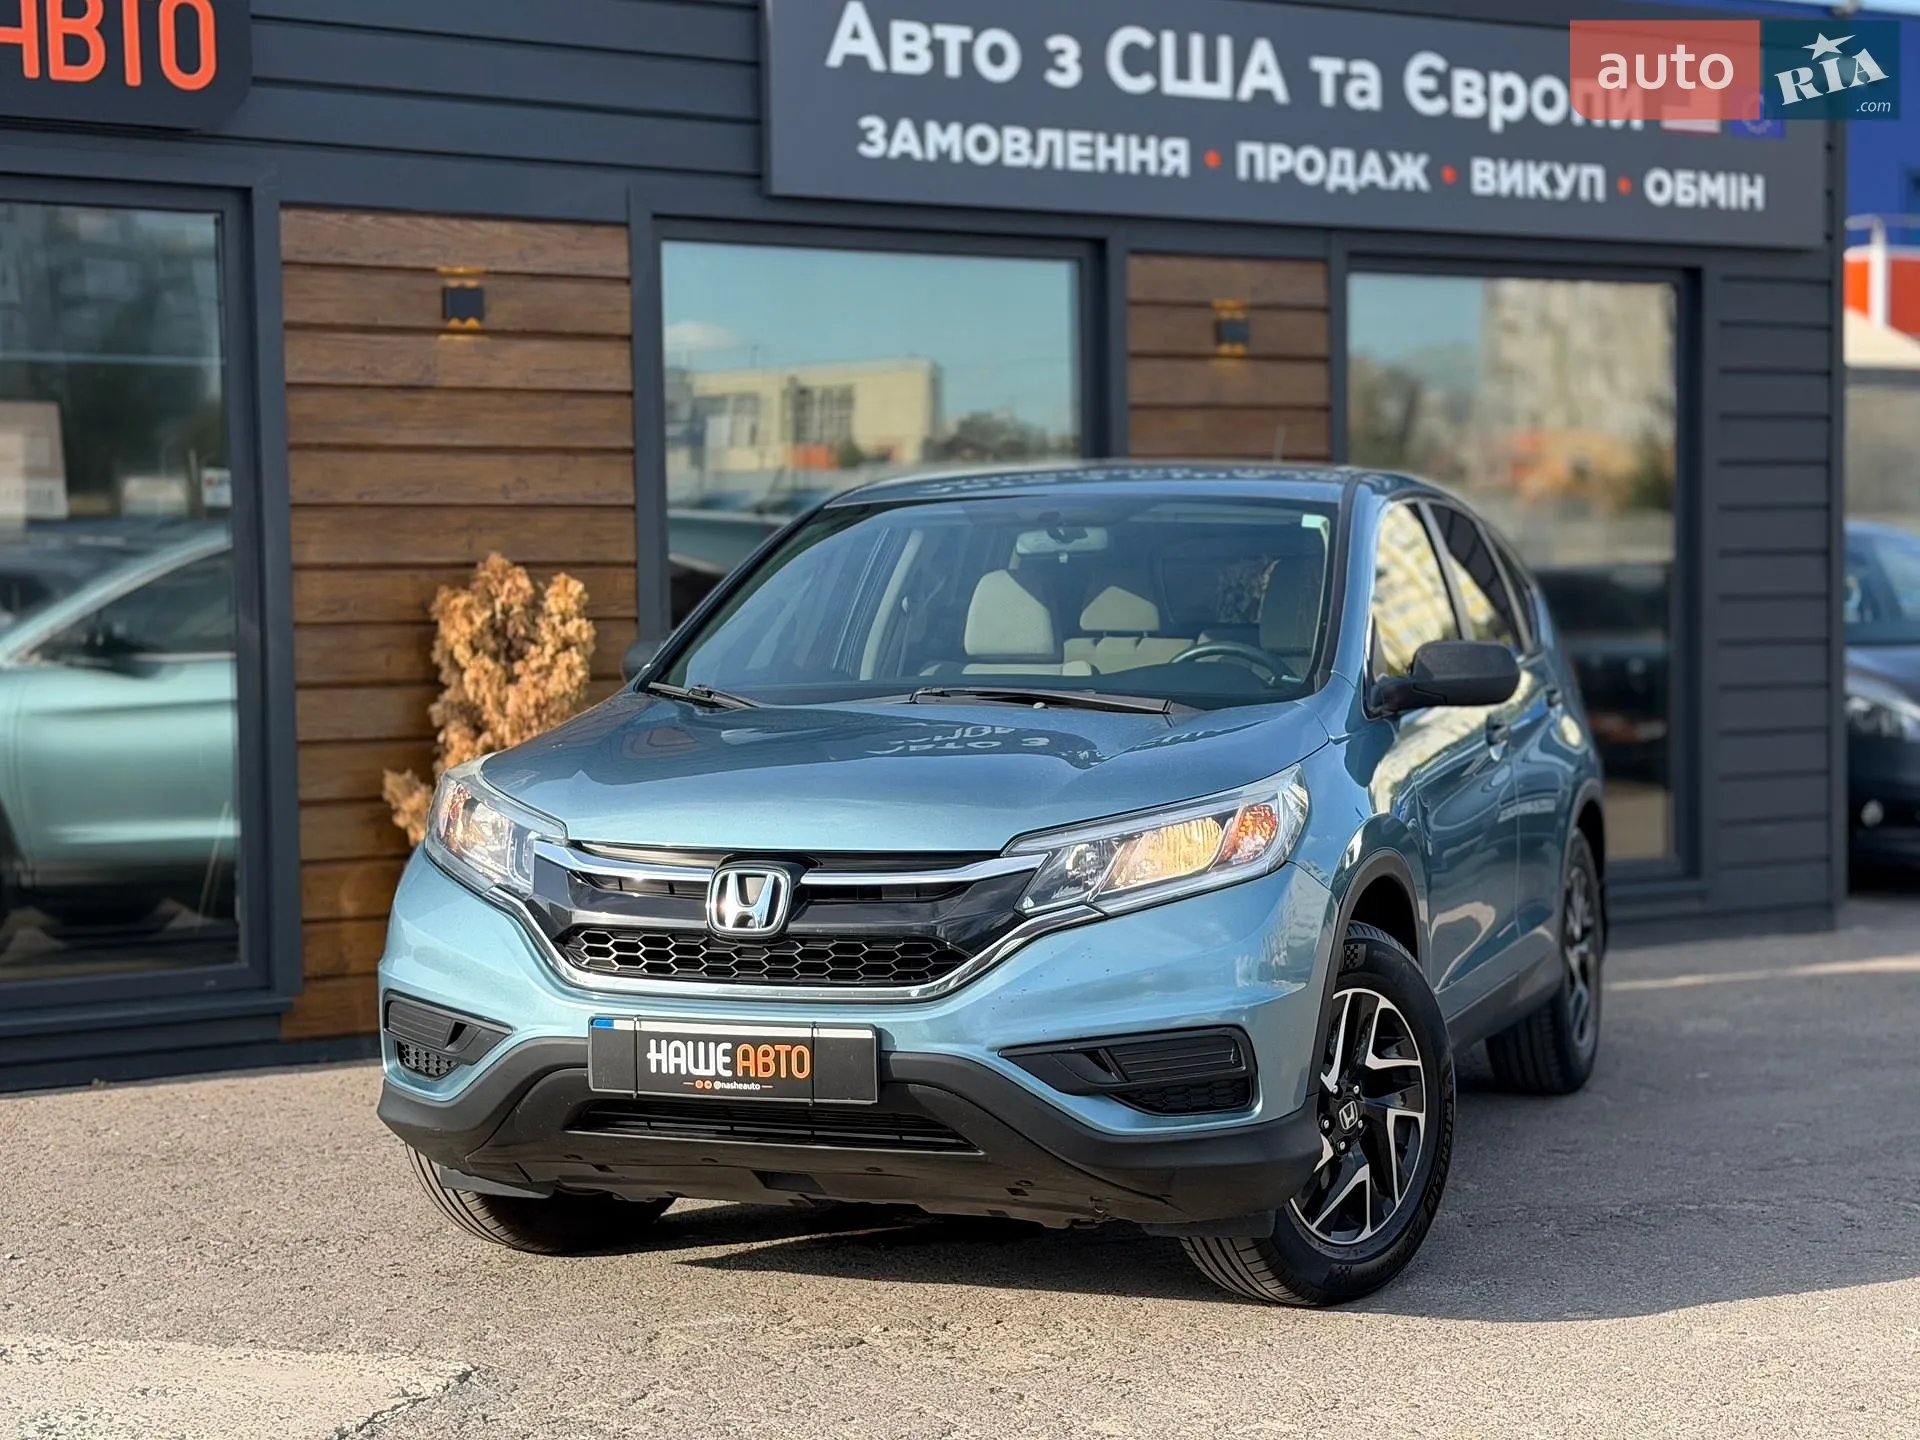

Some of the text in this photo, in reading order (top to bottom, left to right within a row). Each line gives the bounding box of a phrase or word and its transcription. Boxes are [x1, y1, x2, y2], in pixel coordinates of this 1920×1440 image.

[825, 1, 1645, 133] Авто з США та Європи
[857, 115, 1765, 210] ЗАМОВЛЕННЯ ПРОДАЖ ВИКУП ОБМІН
[647, 1039, 811, 1078] НАШЕ АВТО
[713, 1080, 761, 1091] @nasheauto
[1427, 1101, 1453, 1213] MICHELIN
